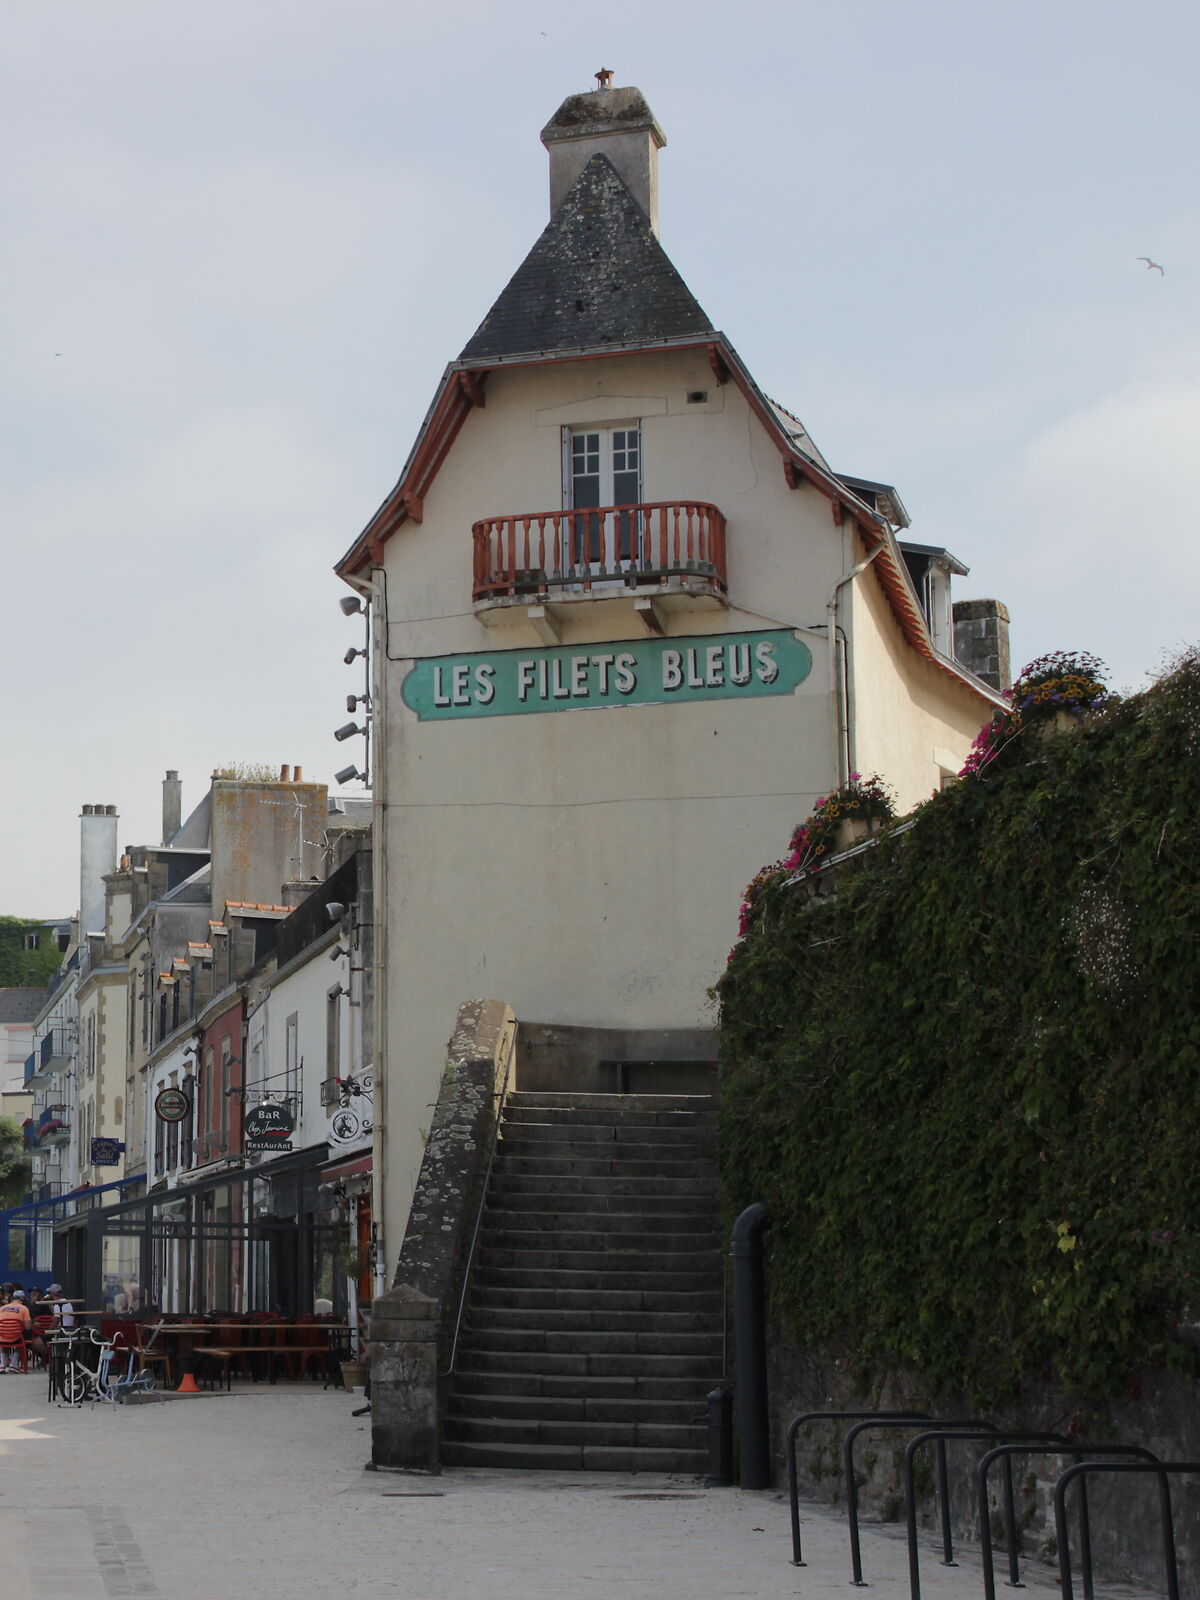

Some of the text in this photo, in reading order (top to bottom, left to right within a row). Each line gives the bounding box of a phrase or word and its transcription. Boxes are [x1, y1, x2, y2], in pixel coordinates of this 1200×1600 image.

[433, 641, 779, 707] LES FILETS BLEUS
